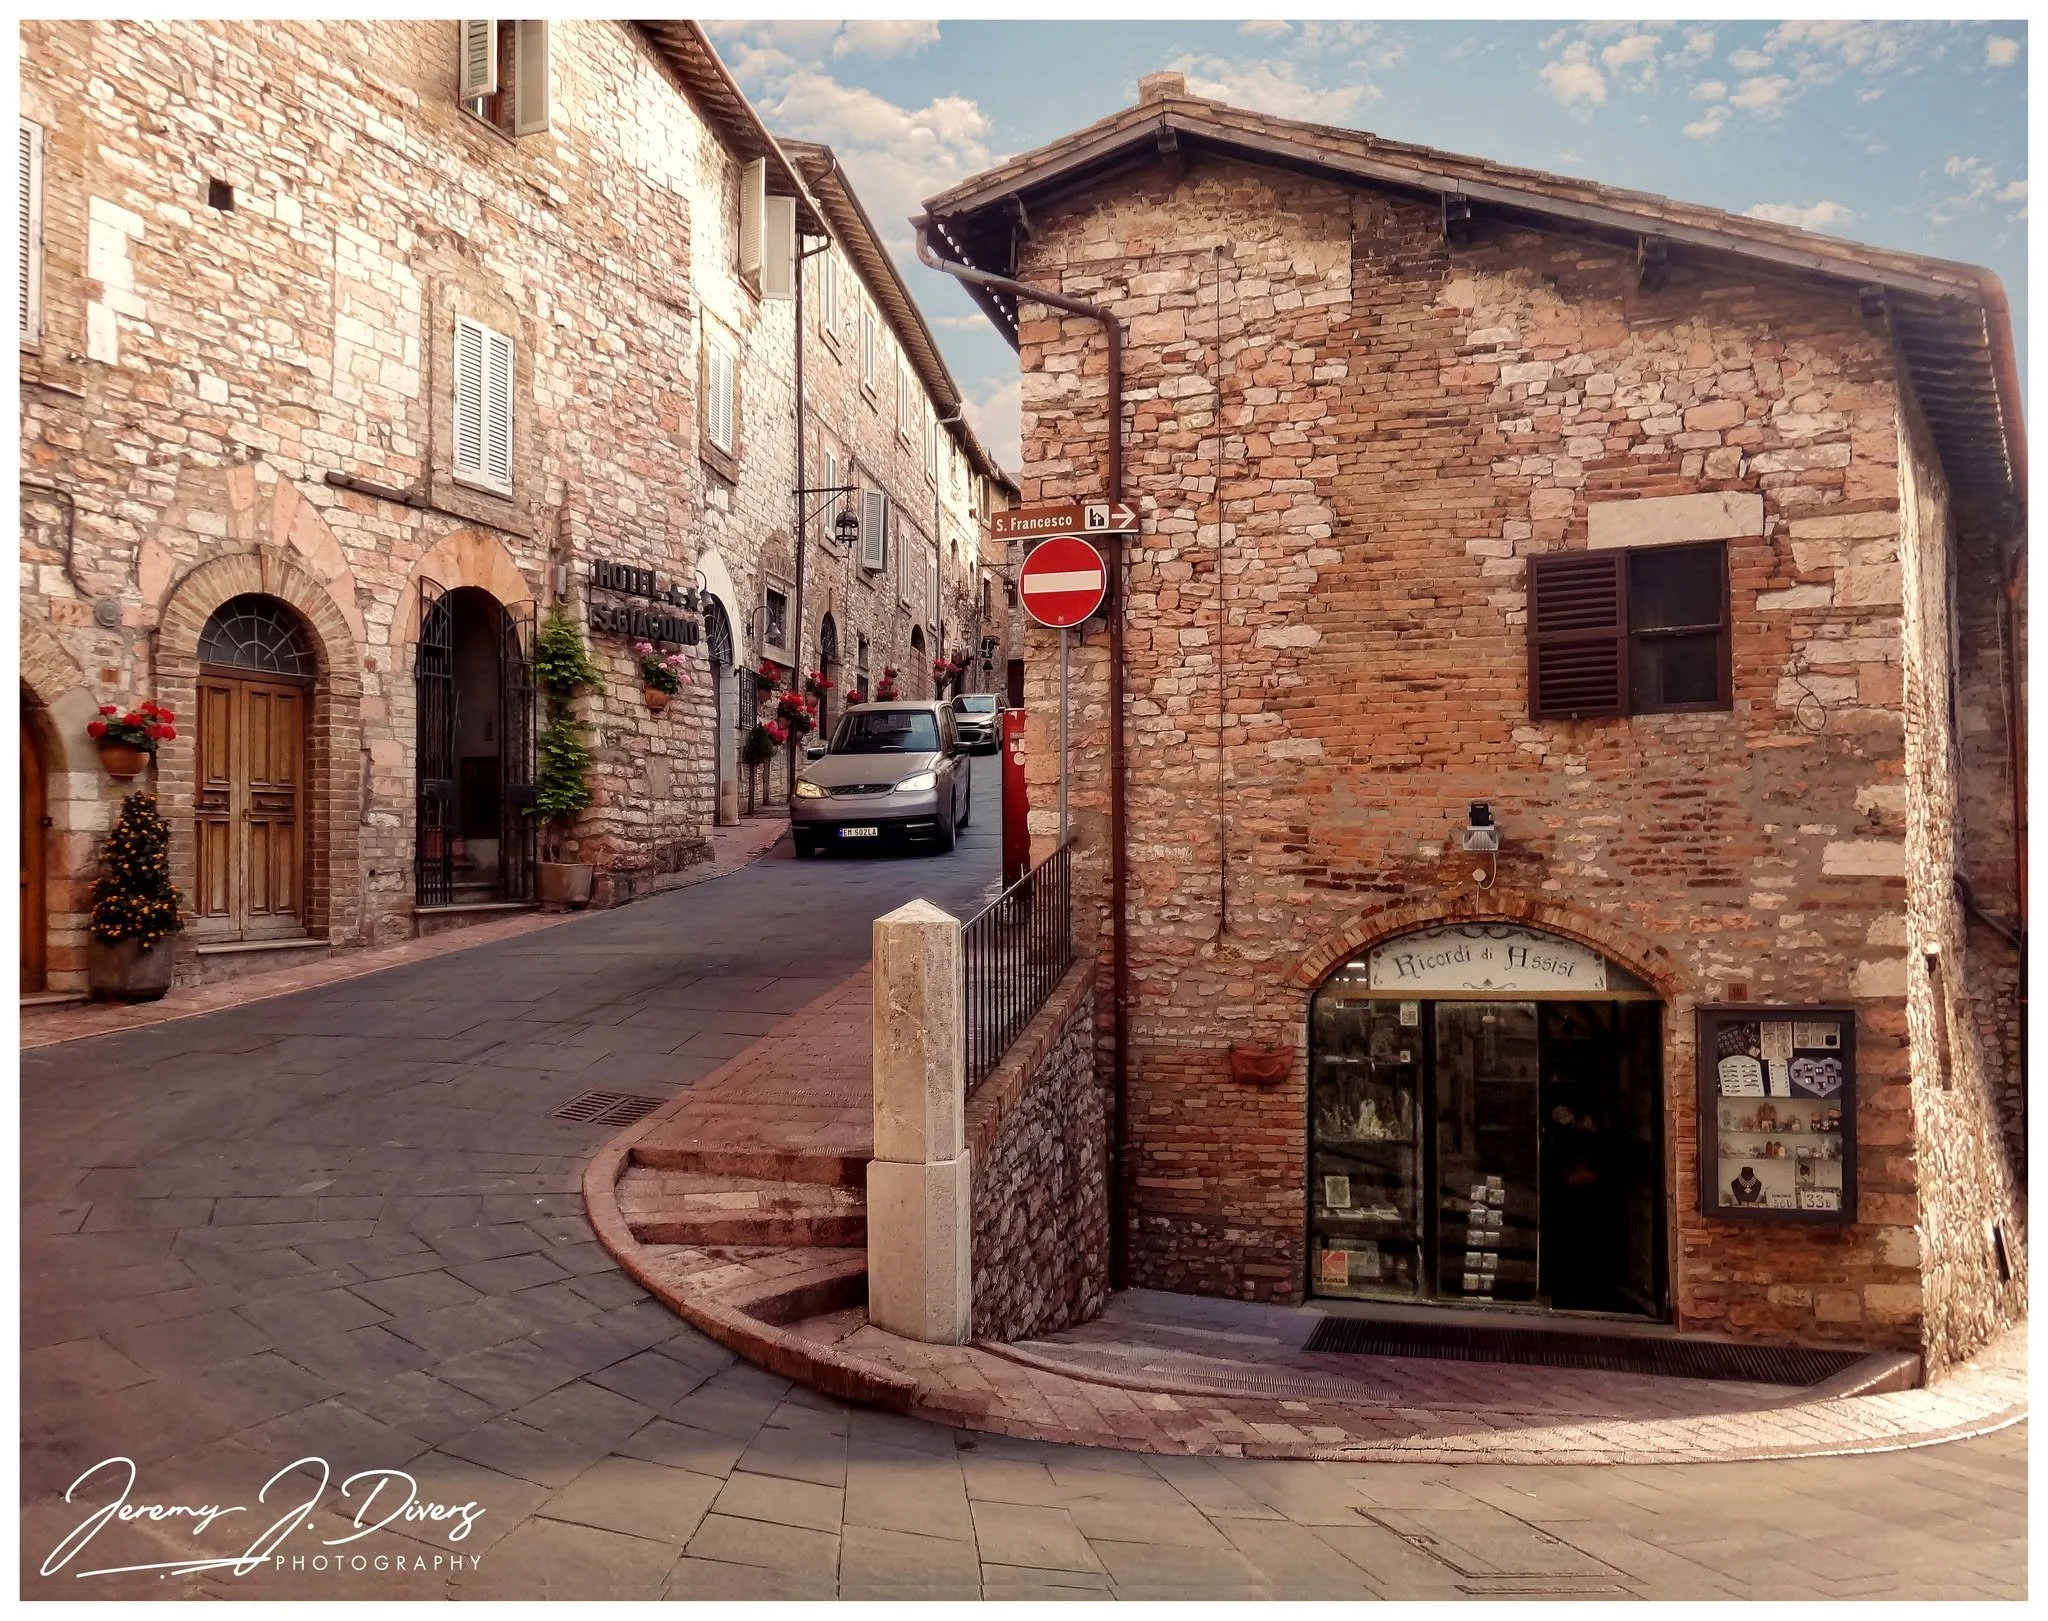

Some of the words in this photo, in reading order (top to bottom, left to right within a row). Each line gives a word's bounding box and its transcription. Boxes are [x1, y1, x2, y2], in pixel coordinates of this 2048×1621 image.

[996, 519, 1008, 532] S.
[1010, 515, 1073, 531] Francesco
[594, 559, 657, 598] HOTEL
[1392, 944, 1473, 980] Ricordi
[1480, 947, 1493, 961] di
[1504, 942, 1577, 979] Assisi
